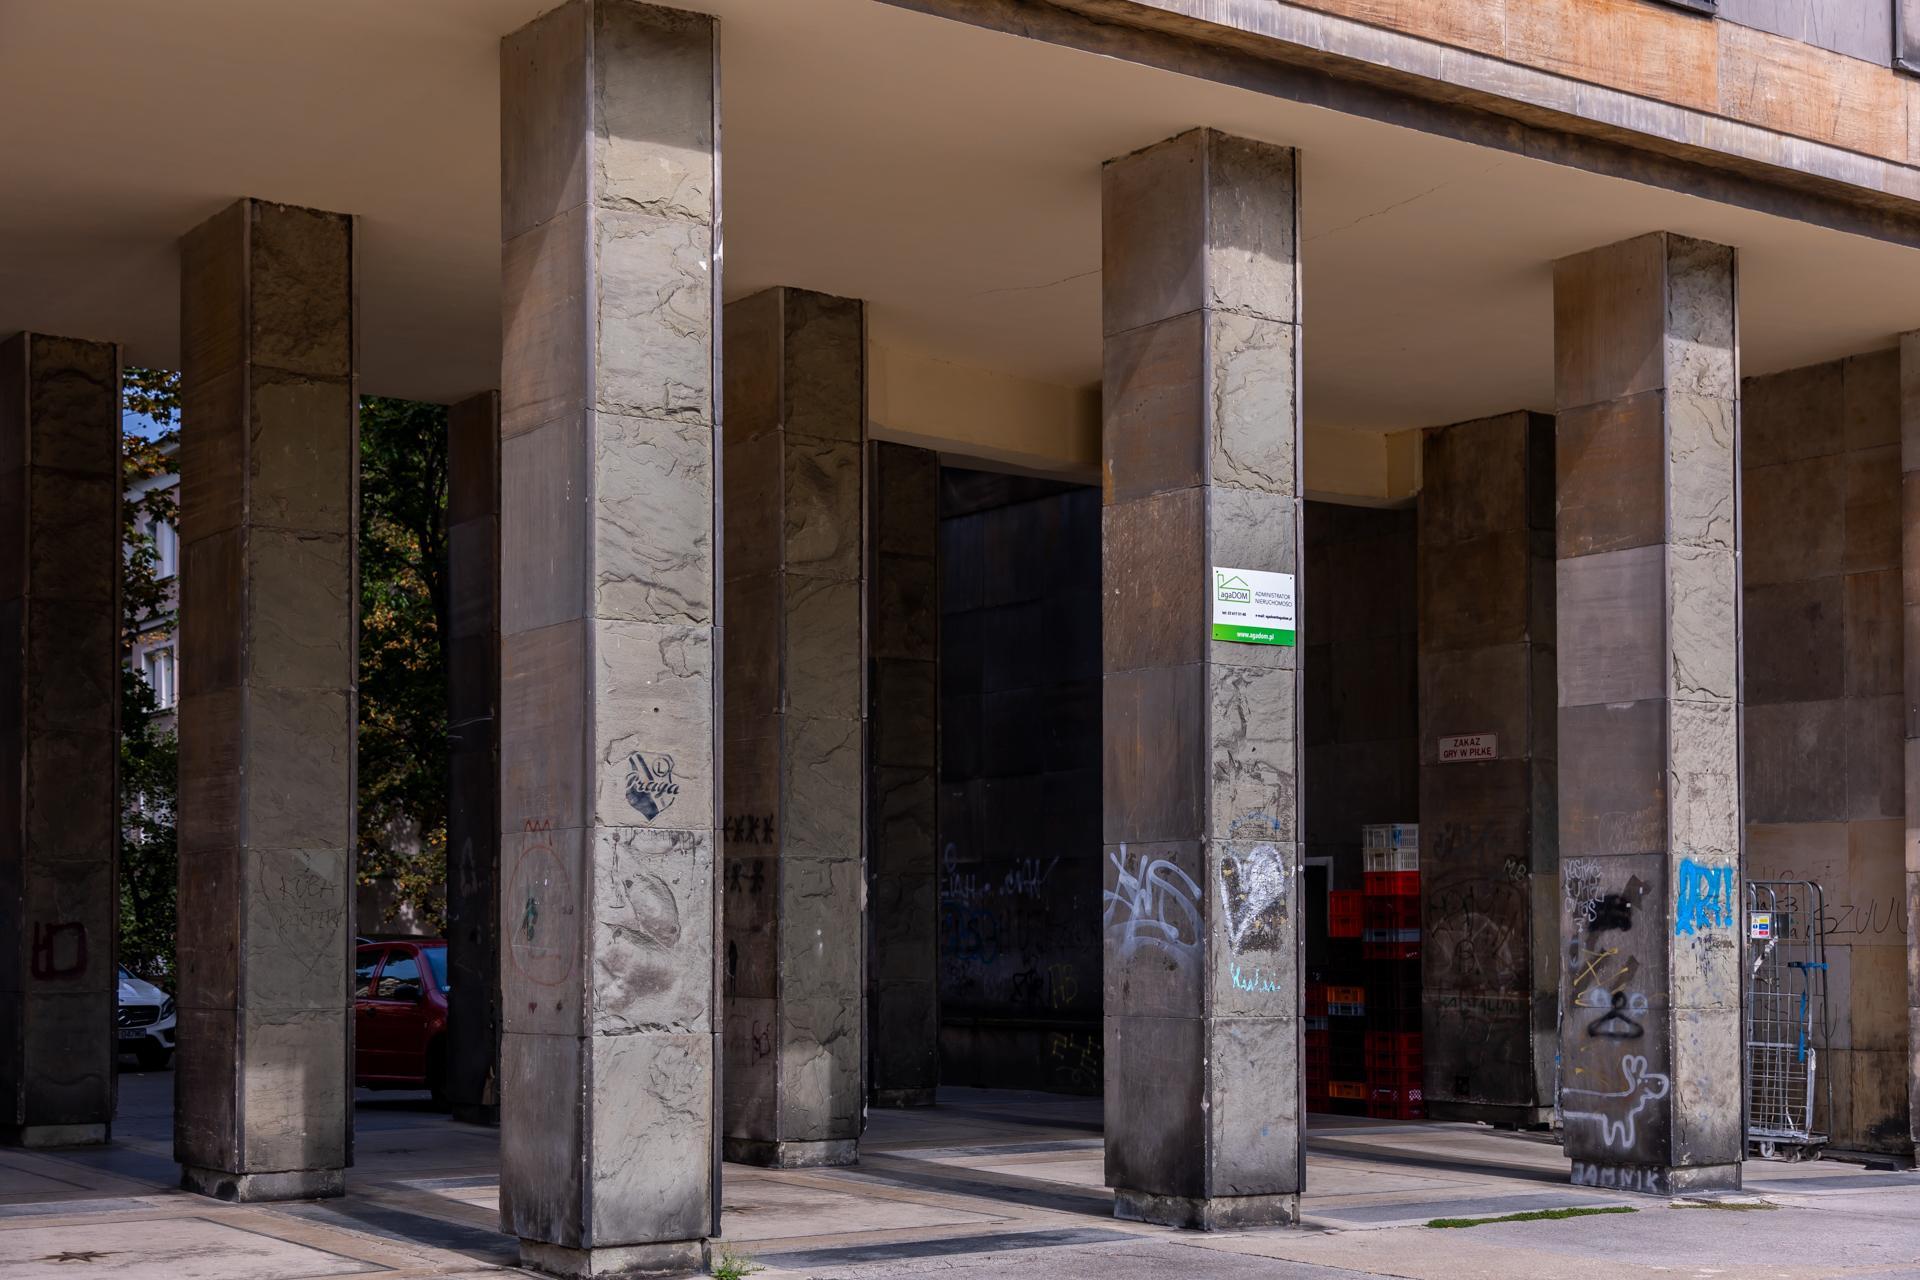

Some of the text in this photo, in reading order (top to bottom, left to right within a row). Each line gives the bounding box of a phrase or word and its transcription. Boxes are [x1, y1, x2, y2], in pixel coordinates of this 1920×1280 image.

[1220, 591, 1248, 600] agaDOM
[1255, 591, 1291, 600] ADMINISTRATOR
[1236, 632, 1275, 641] www.agadom.pl
[1454, 737, 1481, 747] ZAKAZ
[1443, 747, 1492, 758] GRY W PIŁKĘ
[1572, 1162, 1660, 1194] JAMNIK
